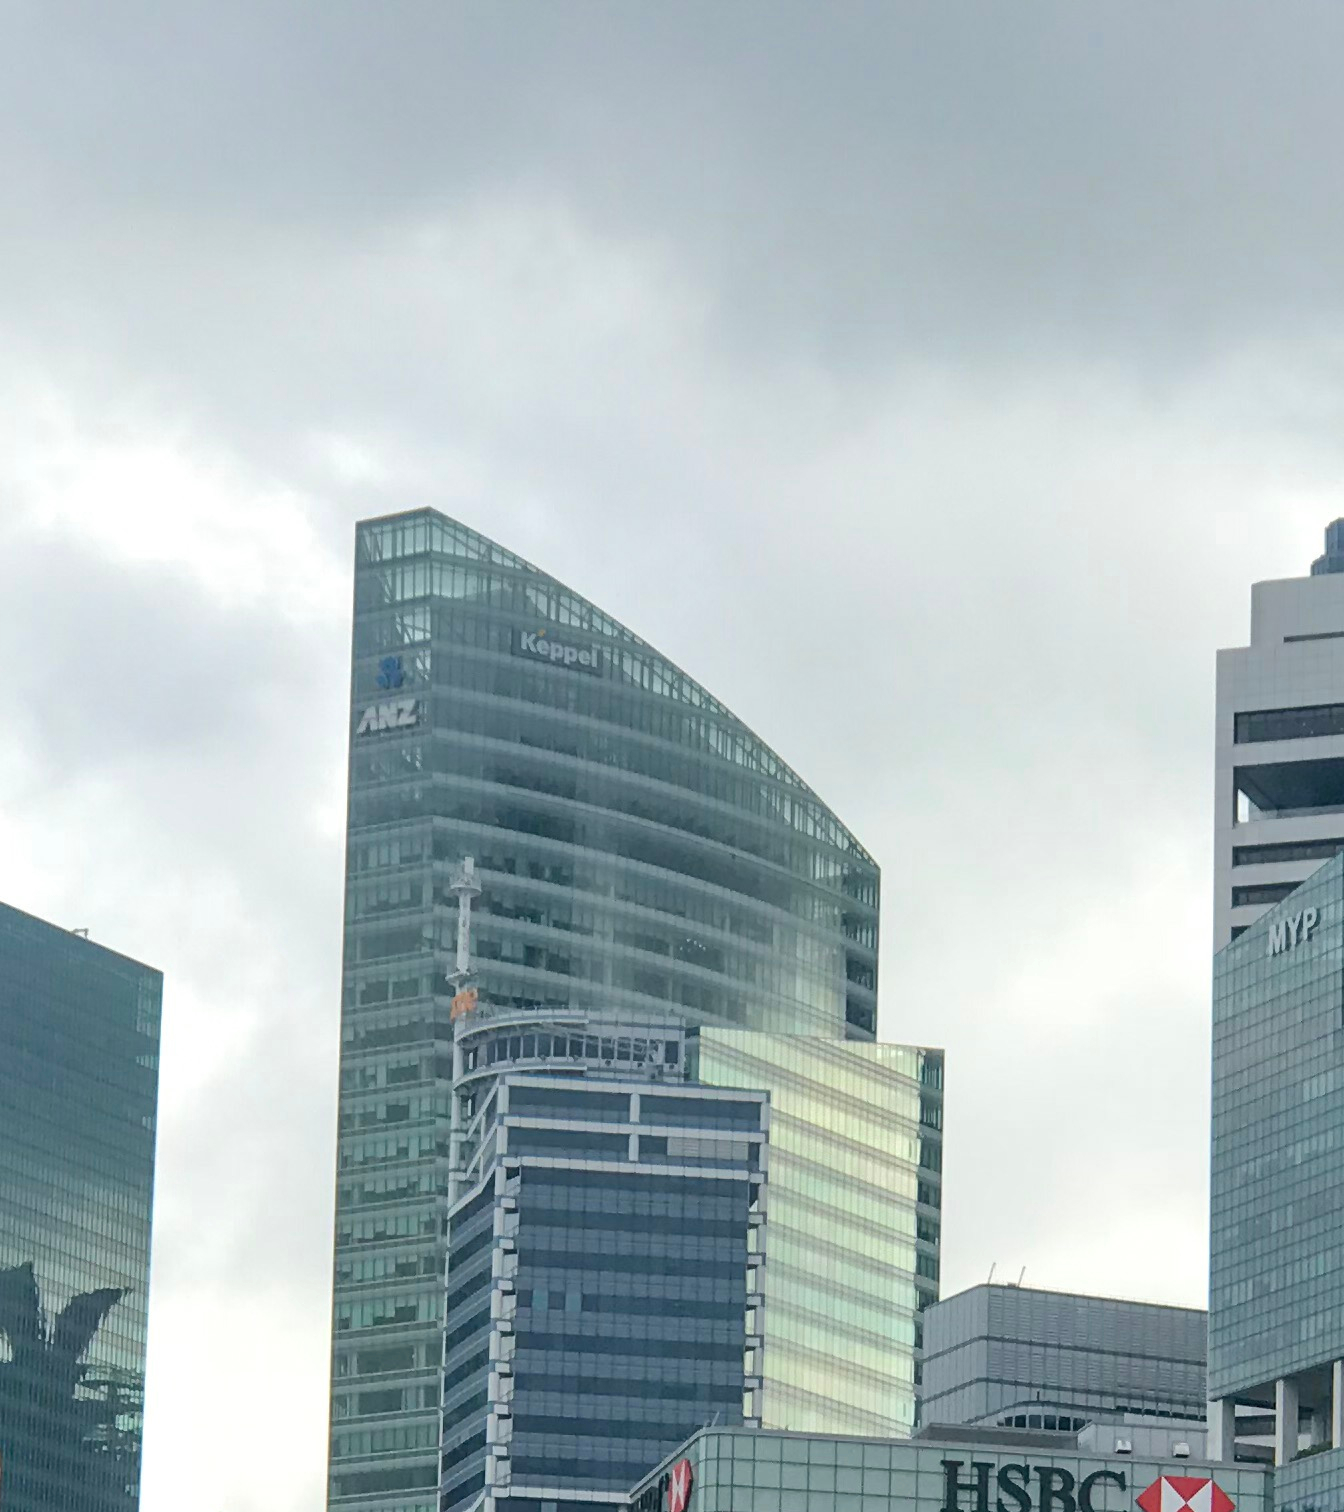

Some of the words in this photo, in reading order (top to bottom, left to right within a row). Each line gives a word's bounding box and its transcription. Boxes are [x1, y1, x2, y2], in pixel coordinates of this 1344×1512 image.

[520, 631, 599, 668] Keppel
[356, 698, 417, 733] ANZ
[1267, 906, 1318, 956] MYP
